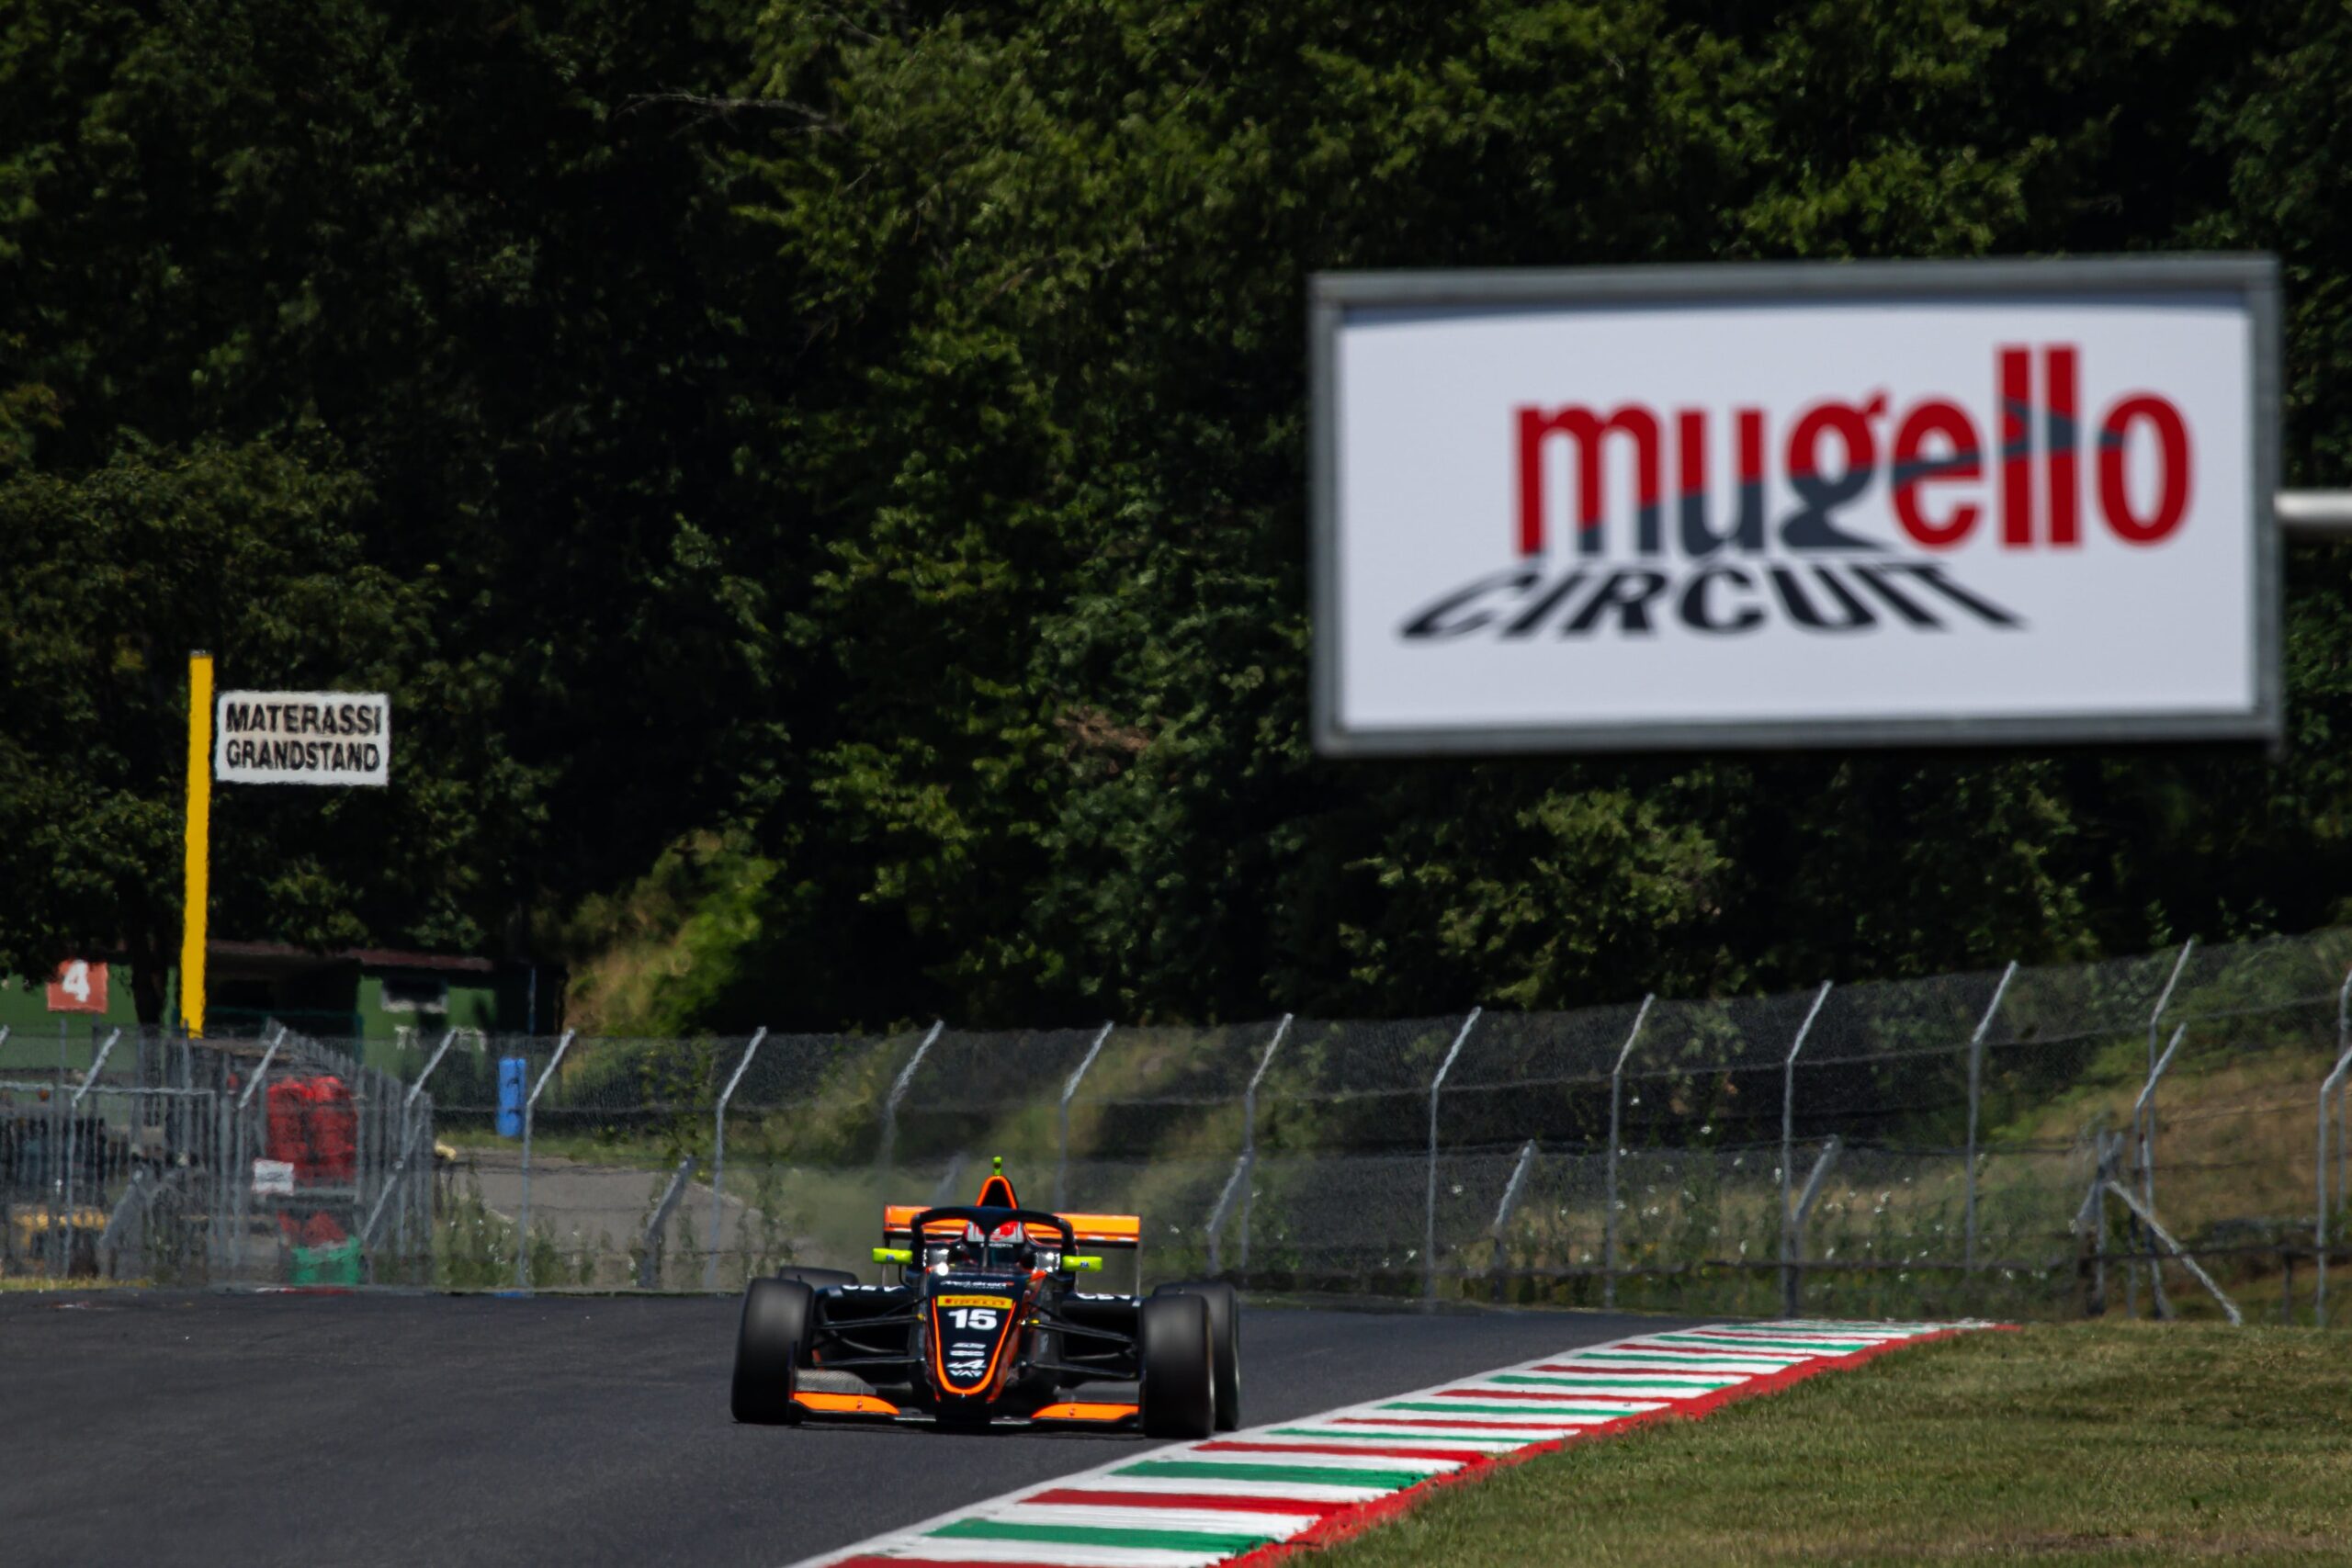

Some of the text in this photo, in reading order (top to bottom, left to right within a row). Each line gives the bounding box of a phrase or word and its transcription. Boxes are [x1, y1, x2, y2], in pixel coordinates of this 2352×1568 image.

[1514, 344, 2194, 557] mugello
[1400, 558, 2029, 641] CIRCUIT
[226, 703, 382, 735] MATERASSI
[226, 739, 380, 772] GRANDSTAND
[62, 959, 90, 1003] 4
[947, 1308, 998, 1331] 15
